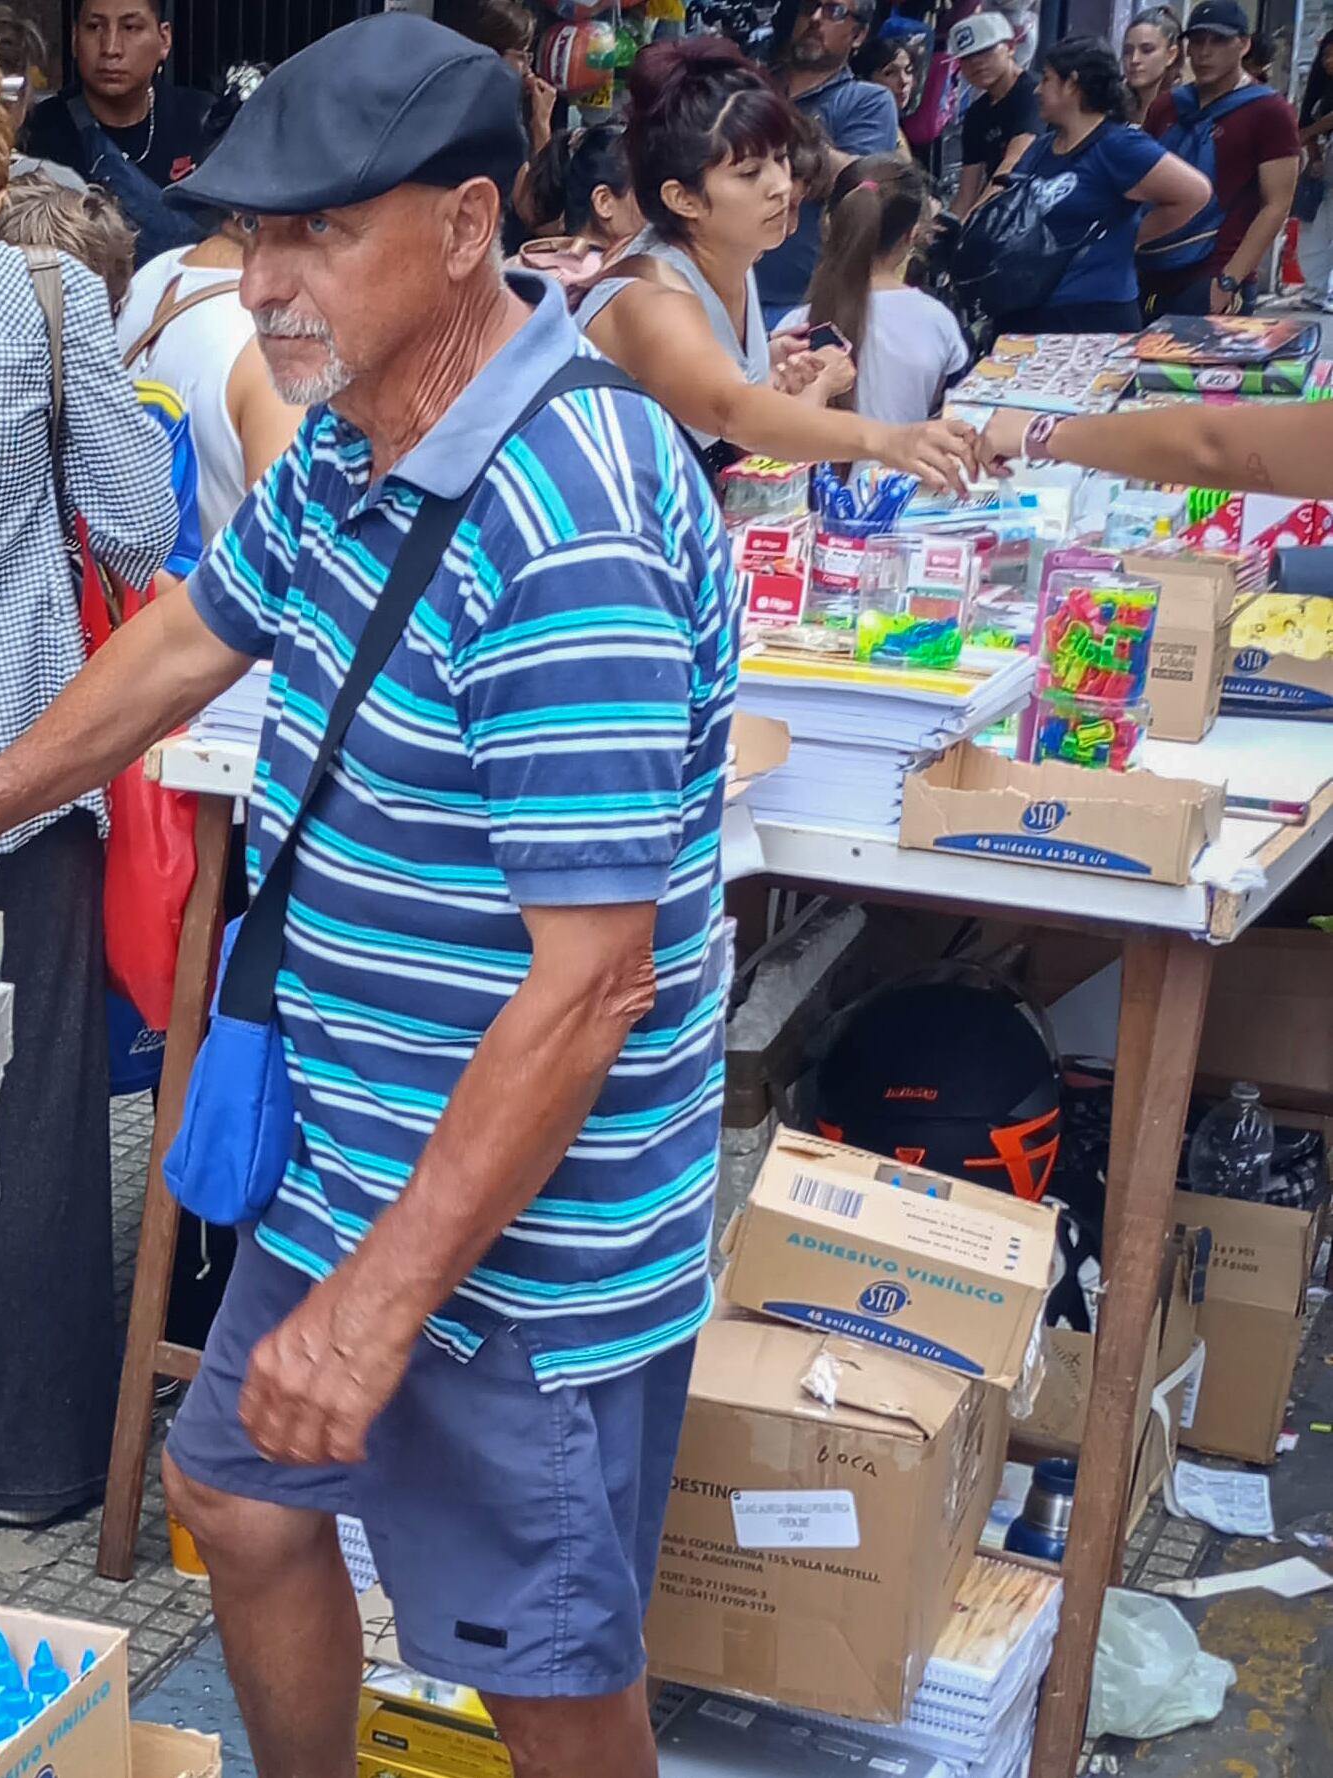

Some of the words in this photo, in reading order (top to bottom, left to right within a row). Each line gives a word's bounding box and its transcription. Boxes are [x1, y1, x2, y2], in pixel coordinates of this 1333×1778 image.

[1028, 803, 1058, 827] STA
[786, 1231, 900, 1274] ADHESIVO
[905, 1264, 1005, 1306] VINÍLICO
[867, 1285, 898, 1313] STA
[701, 1553, 765, 1573] ARGENTINA
[791, 1556, 823, 1573] VILLA
